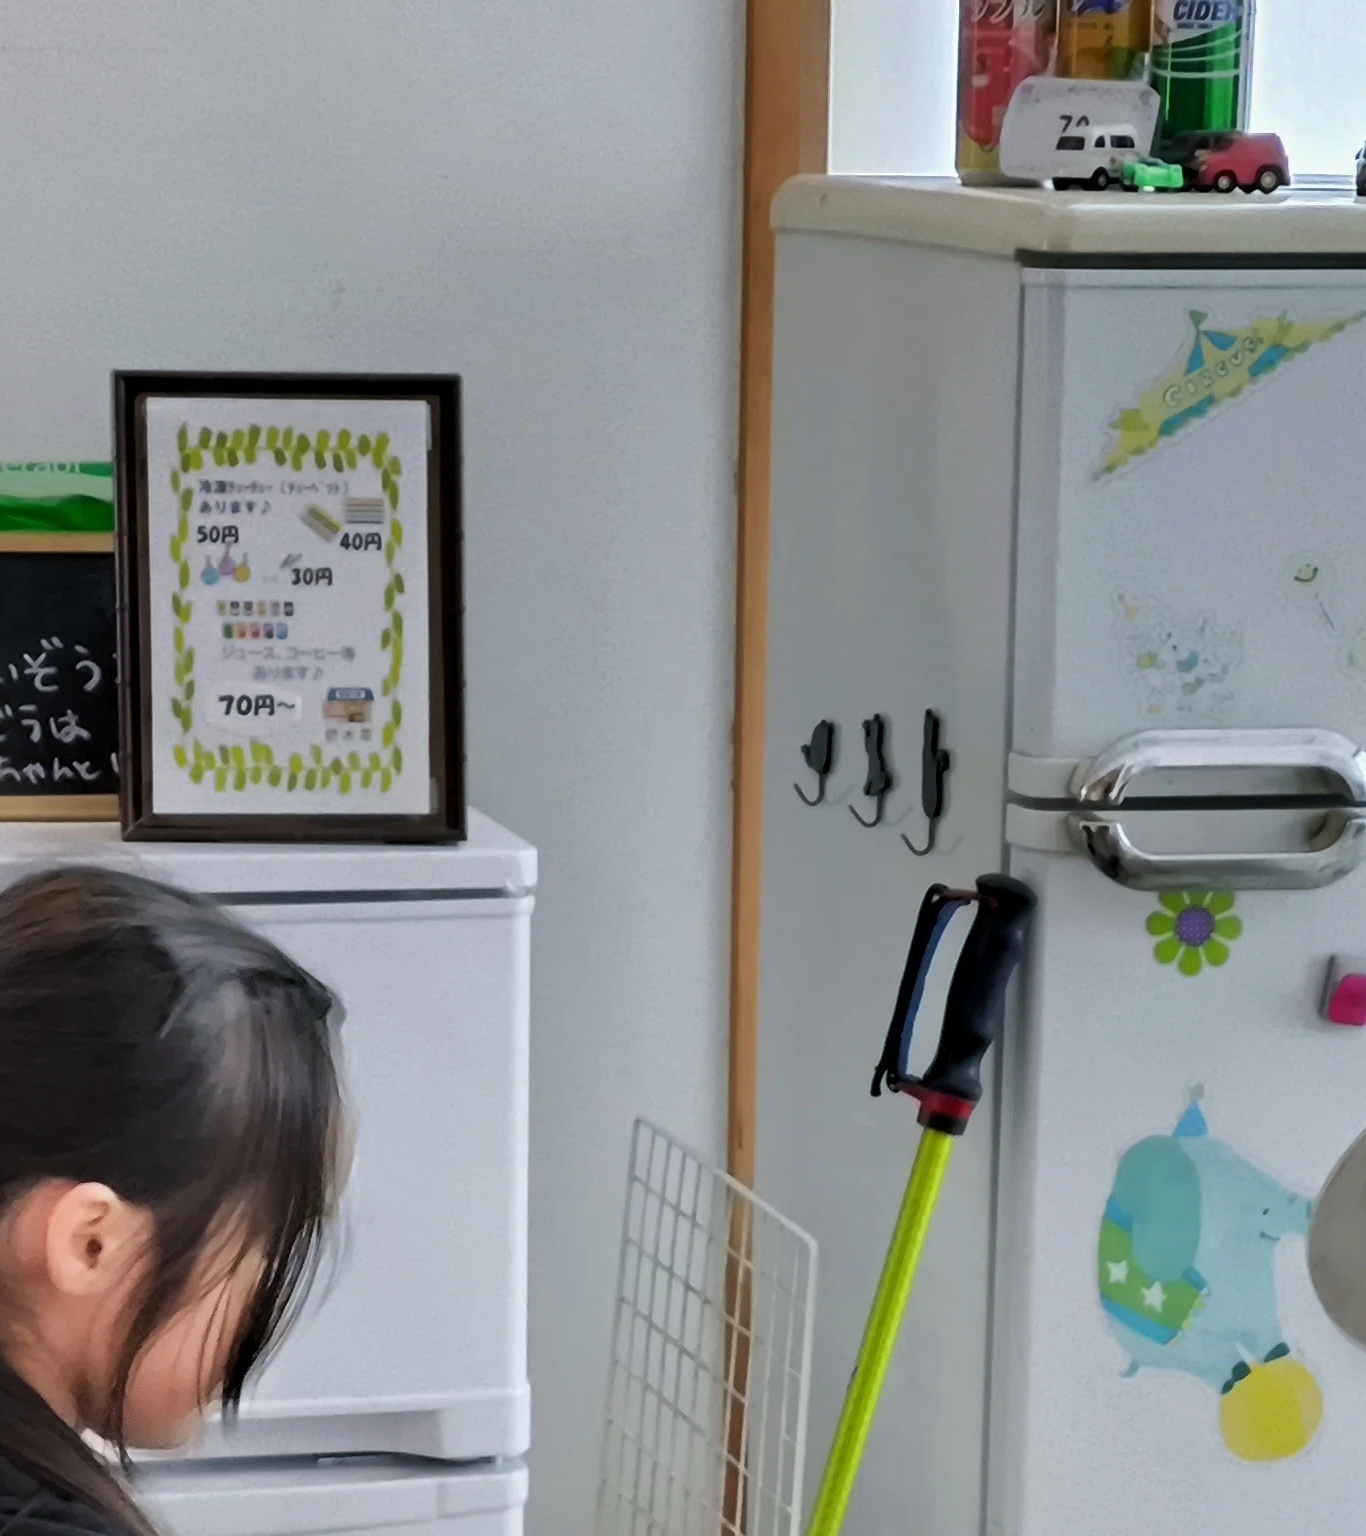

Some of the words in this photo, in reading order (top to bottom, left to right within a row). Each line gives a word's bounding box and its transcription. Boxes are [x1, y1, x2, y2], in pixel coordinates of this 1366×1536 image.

[197, 525, 239, 543] 50円
[339, 533, 382, 550] 40円
[291, 567, 333, 586] 30円
